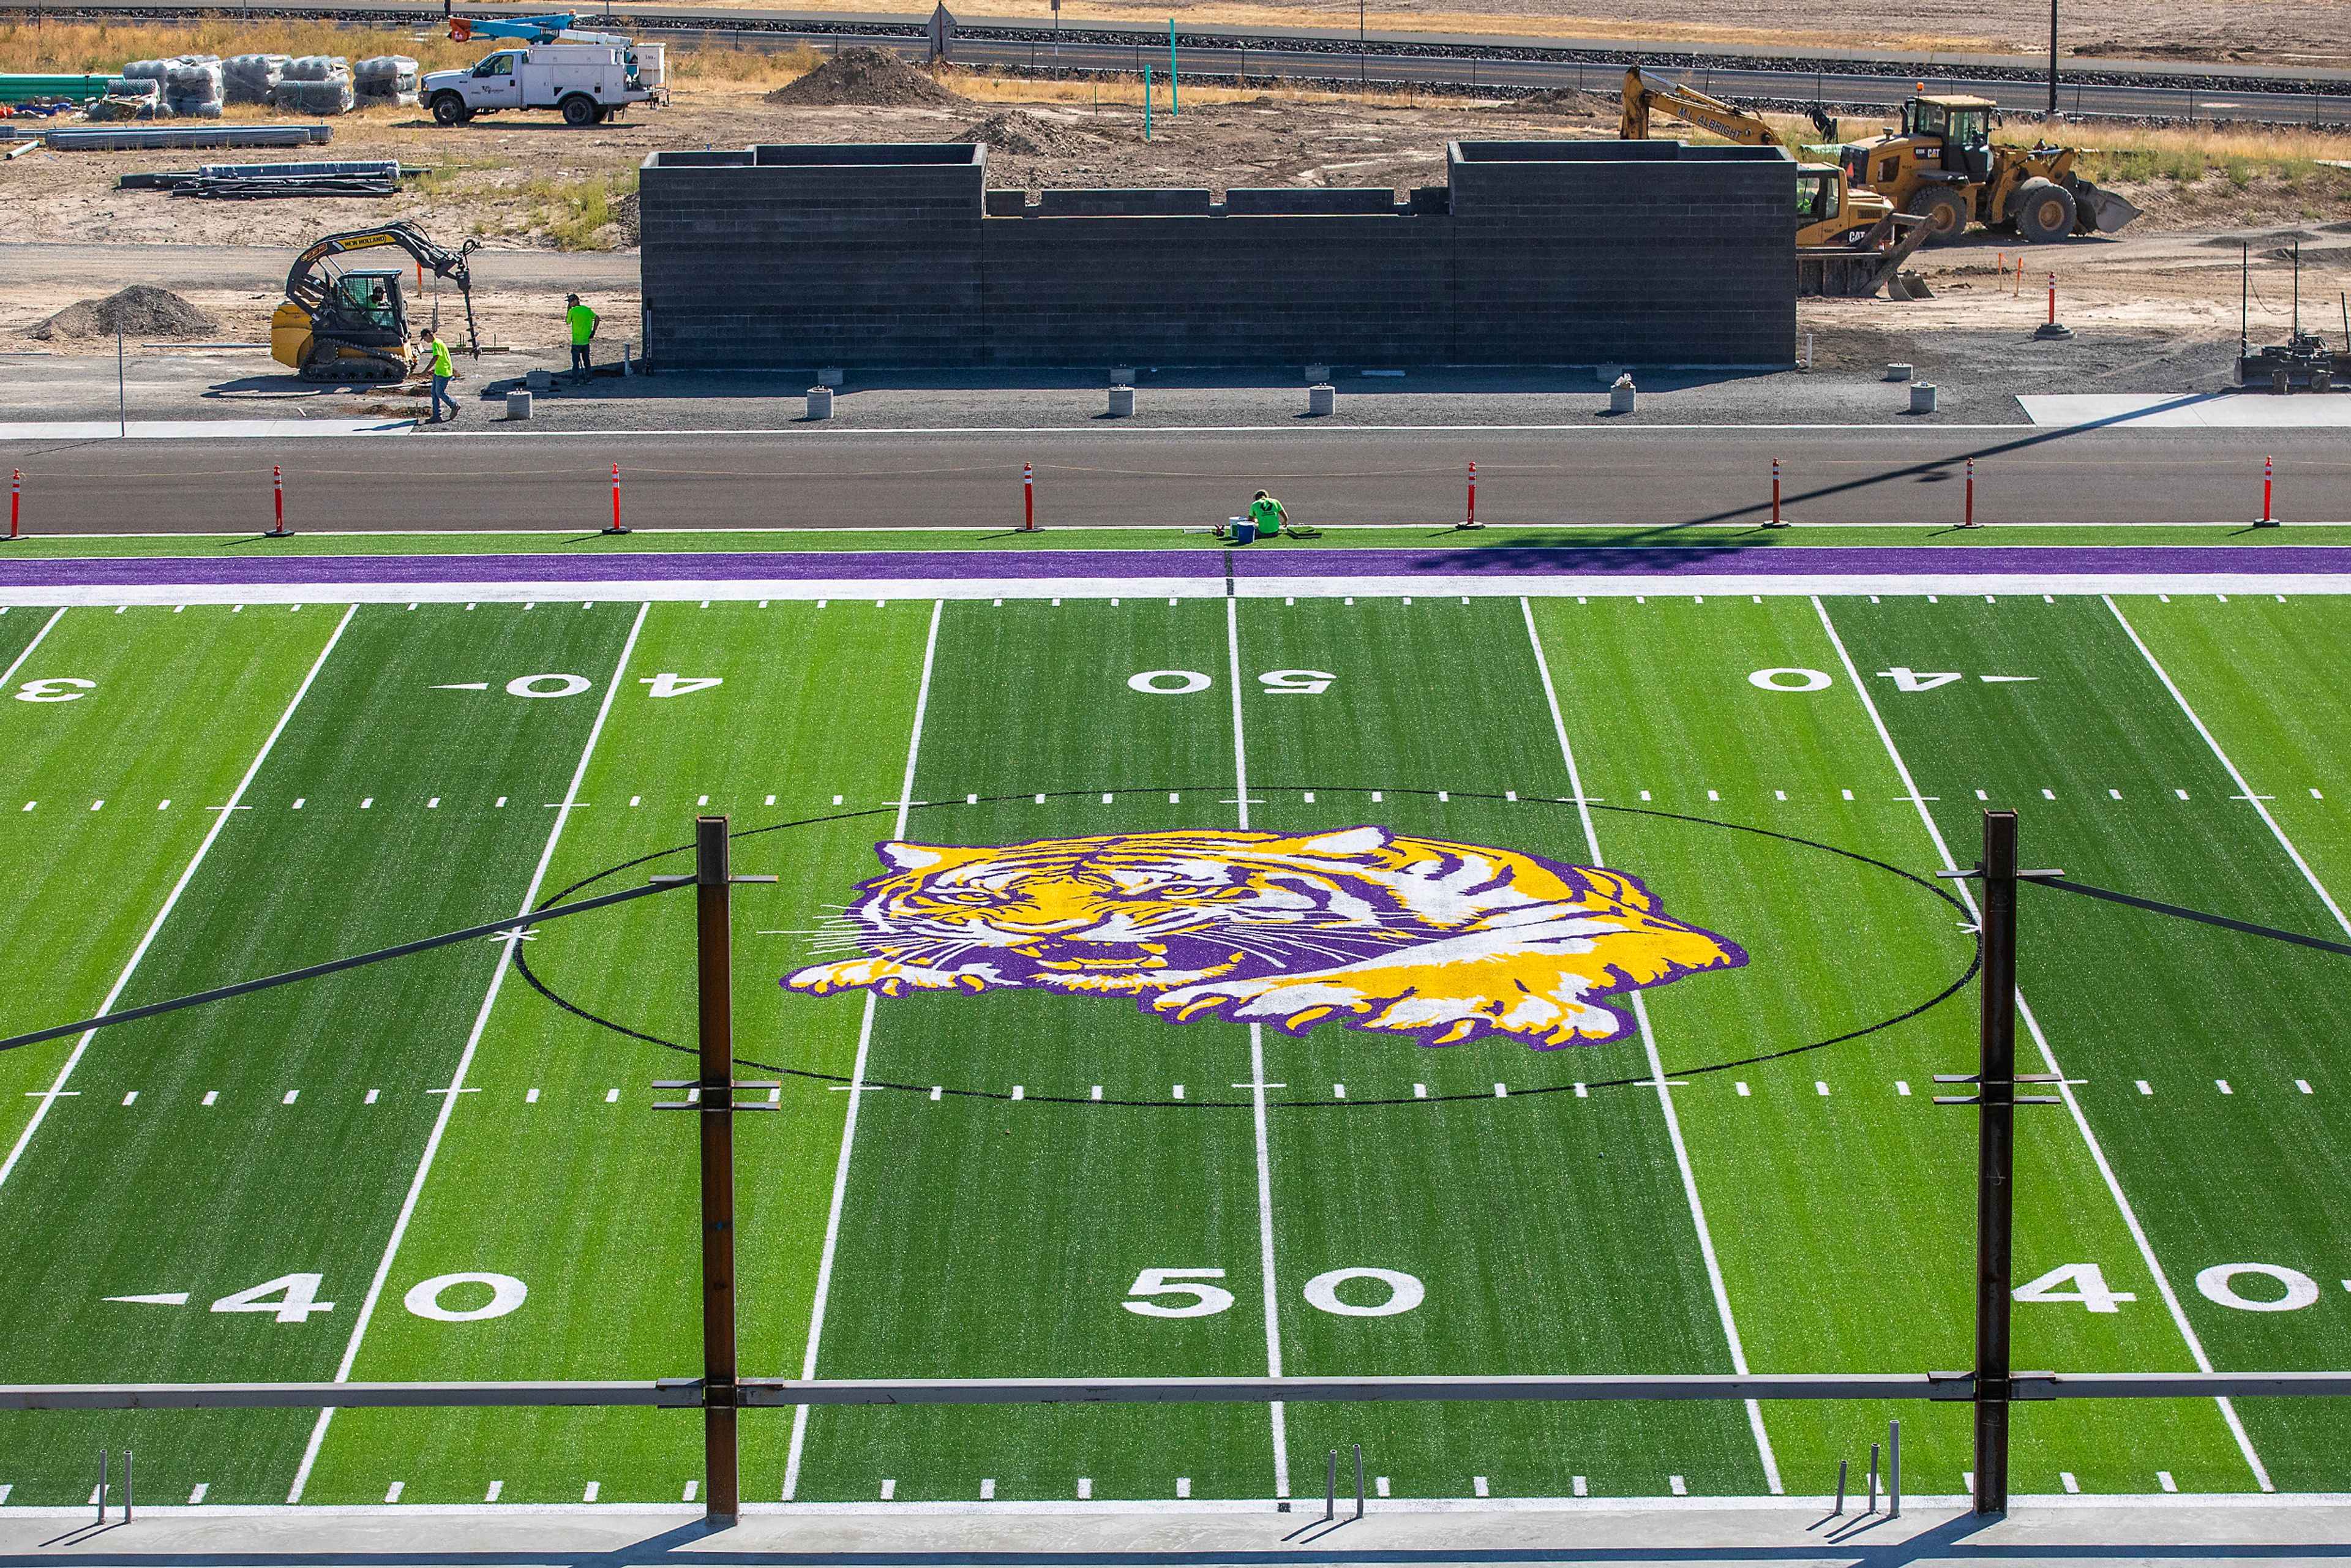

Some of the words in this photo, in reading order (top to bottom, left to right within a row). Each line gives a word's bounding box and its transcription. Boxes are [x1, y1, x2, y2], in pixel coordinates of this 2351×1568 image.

[1678, 107, 1694, 121] M.L.
[1697, 115, 1742, 139] ALBRIGHT
[1927, 149, 1940, 157] CAT
[359, 236, 384, 245] HOLLAND
[1849, 231, 1865, 243] CAT
